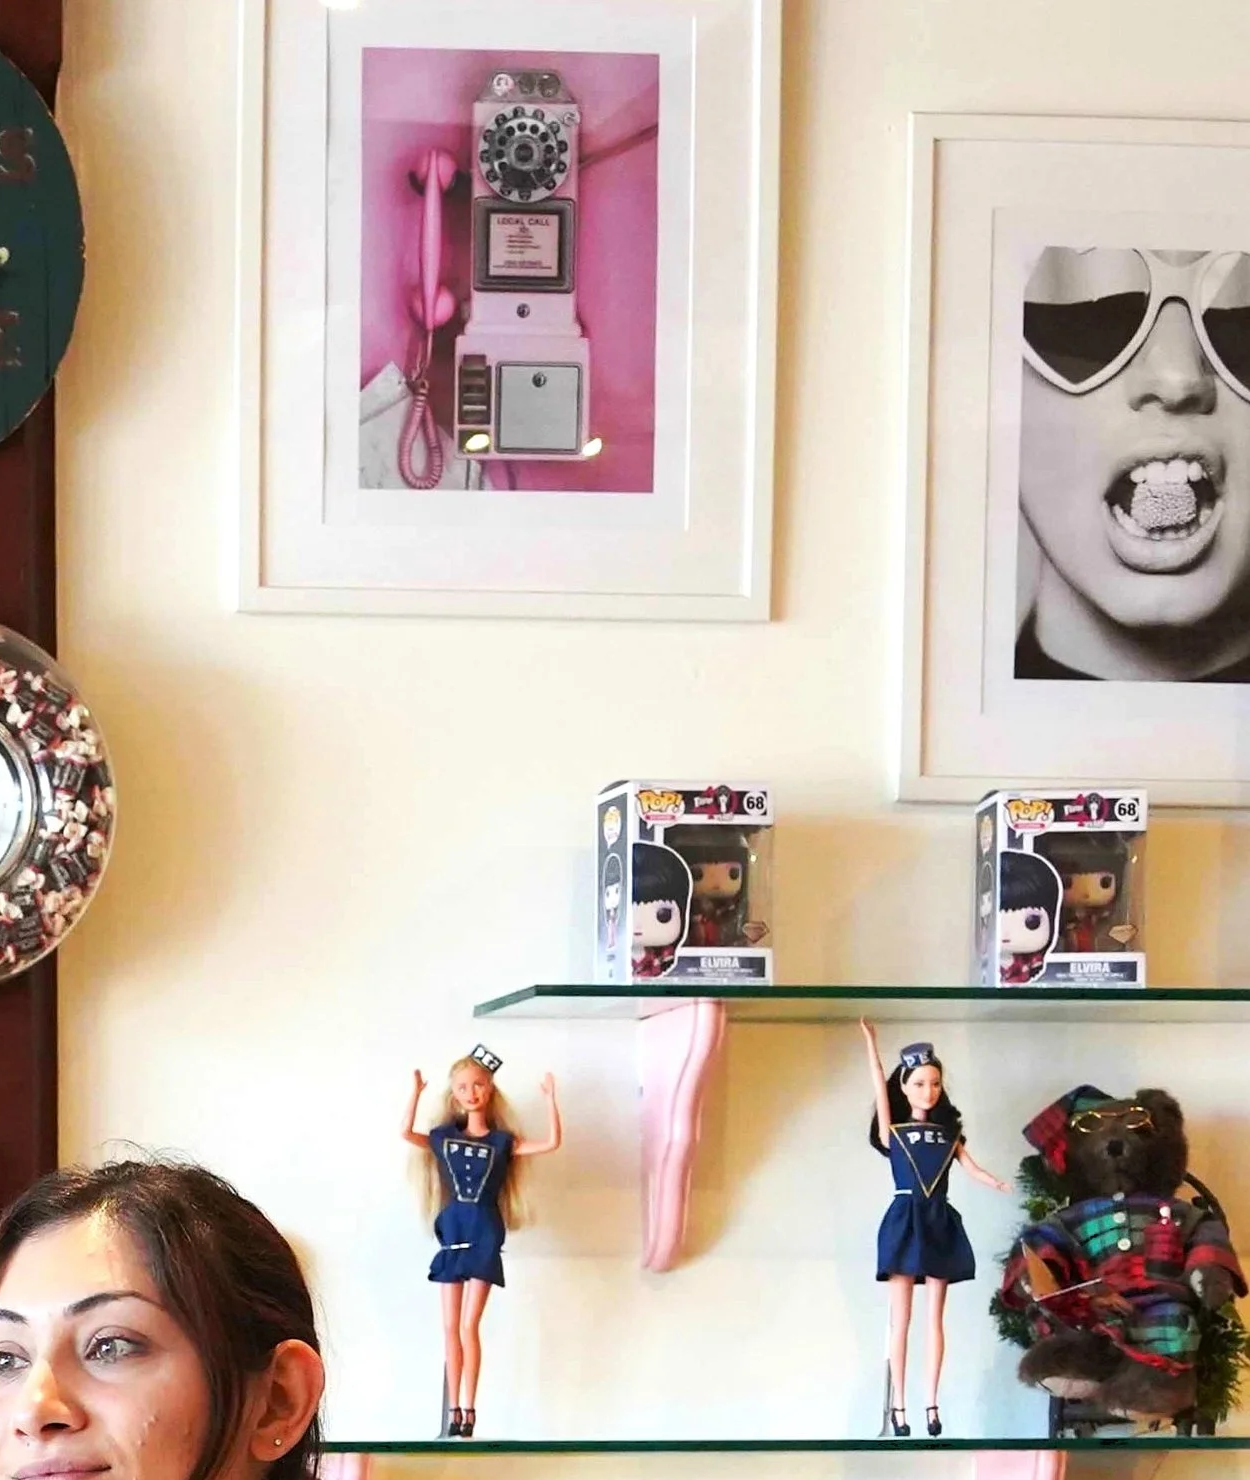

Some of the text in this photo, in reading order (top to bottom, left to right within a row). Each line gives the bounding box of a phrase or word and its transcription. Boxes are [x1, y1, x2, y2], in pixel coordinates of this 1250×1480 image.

[528, 218, 550, 226] CALL
[746, 797, 765, 810] 68
[1117, 803, 1136, 817] 68
[700, 957, 740, 969] ELVIRA
[1070, 962, 1110, 974] ELVIRA
